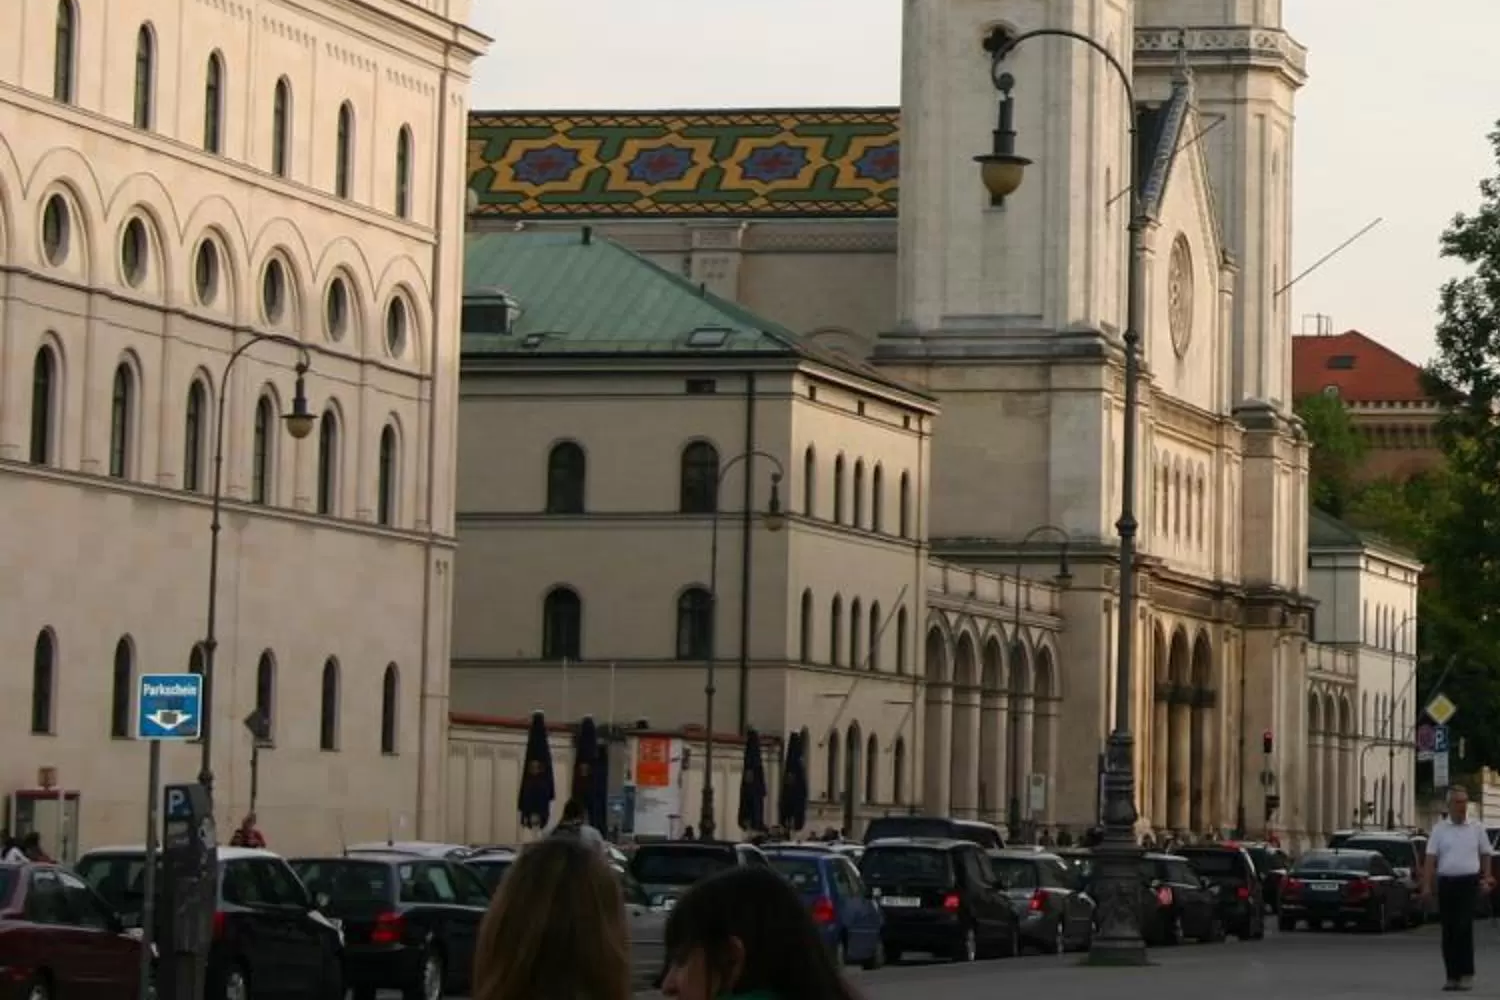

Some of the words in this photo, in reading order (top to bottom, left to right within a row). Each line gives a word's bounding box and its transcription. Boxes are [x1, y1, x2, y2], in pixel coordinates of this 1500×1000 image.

[143, 683, 197, 697] Parkschein
[1435, 730, 1444, 750] P
[168, 789, 185, 815] P
